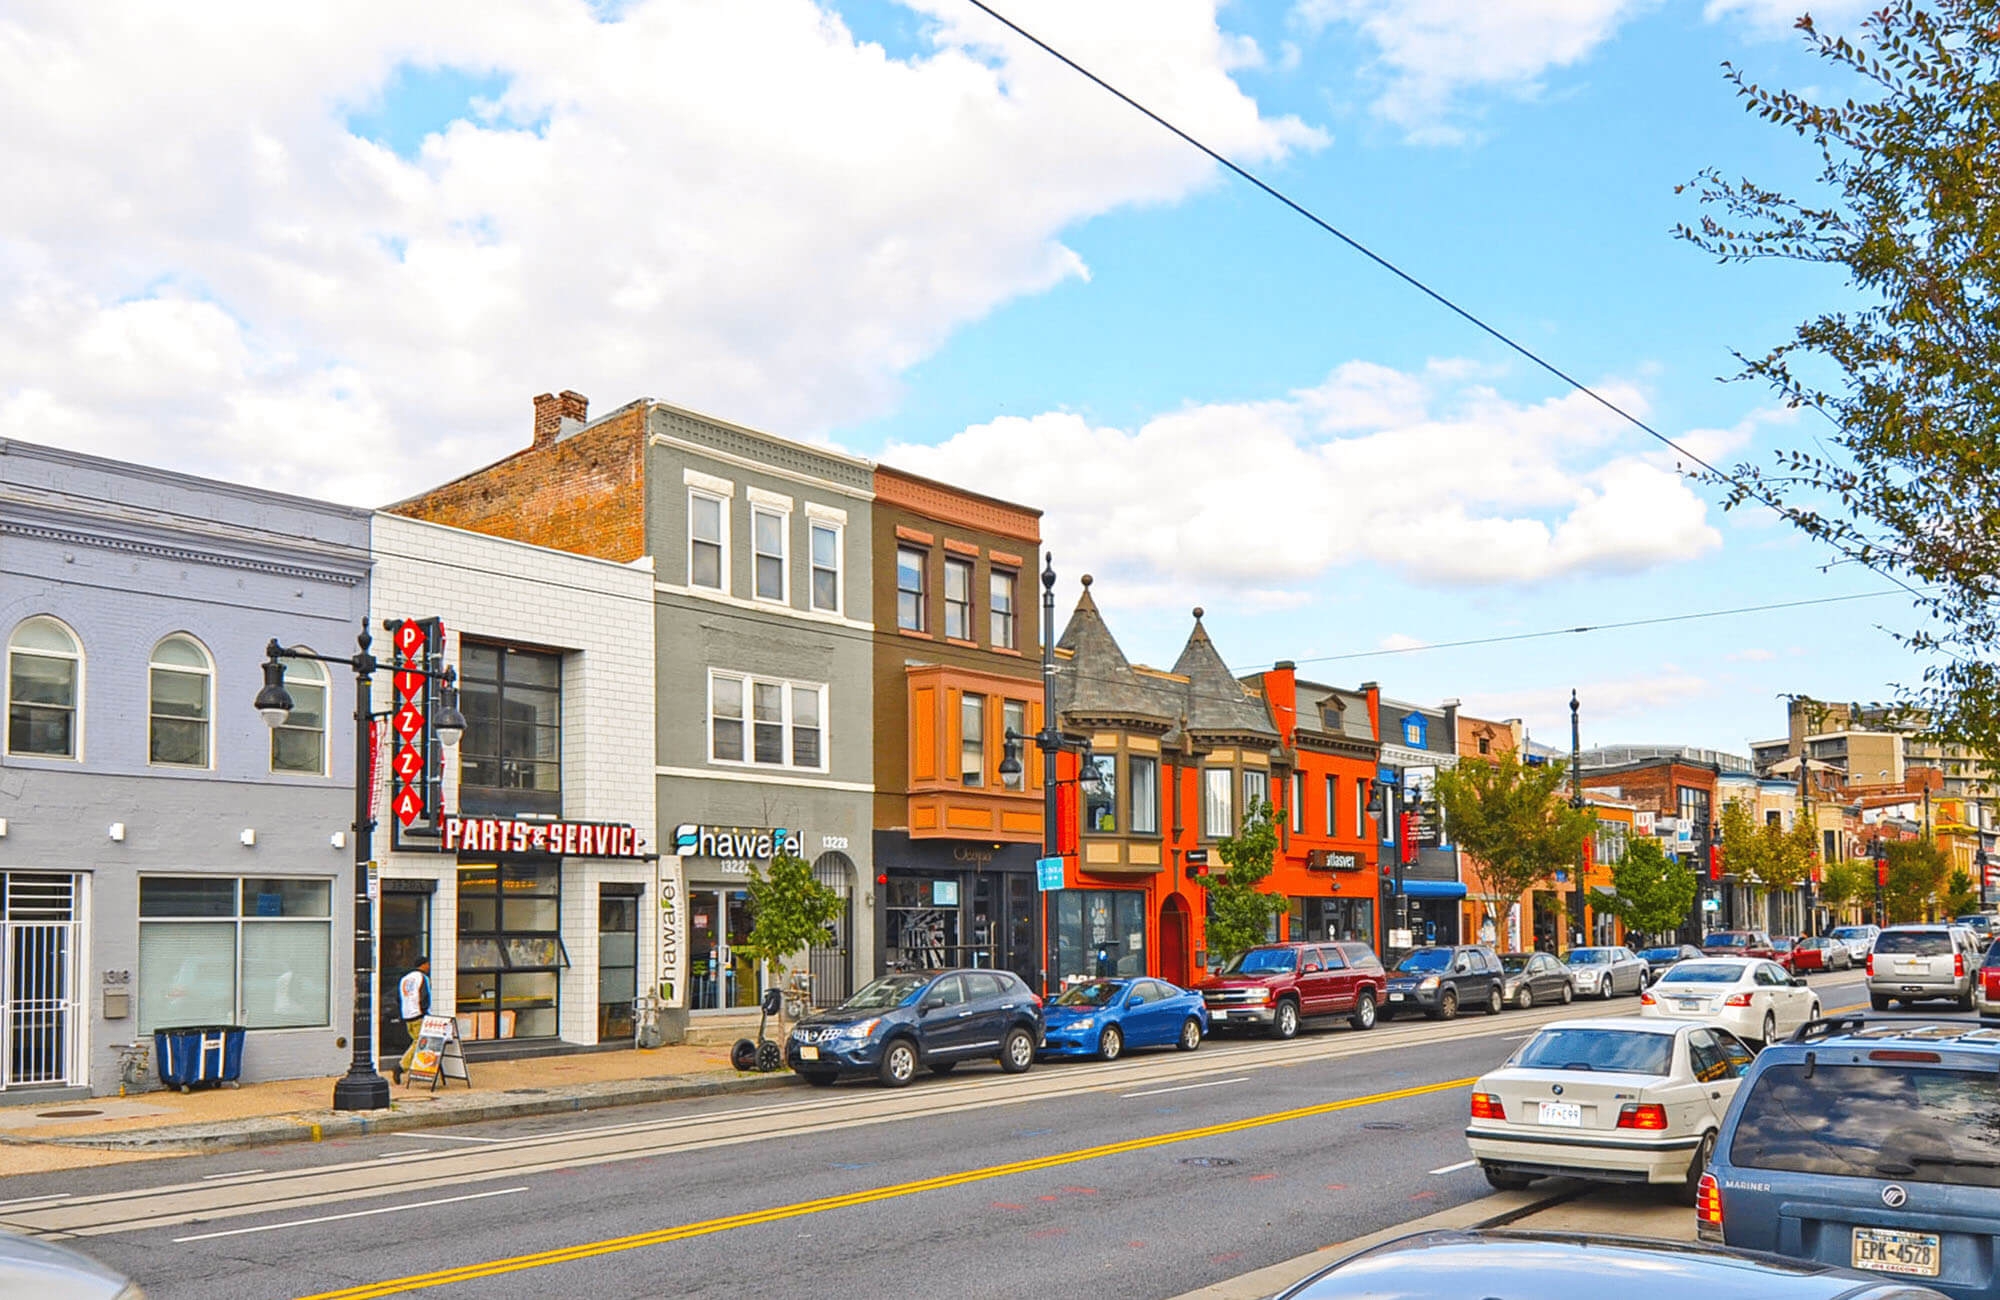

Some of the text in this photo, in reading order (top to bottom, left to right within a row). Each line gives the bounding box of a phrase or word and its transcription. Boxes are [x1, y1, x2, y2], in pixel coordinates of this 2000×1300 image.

[399, 627, 416, 814] PIZZA
[445, 817, 646, 856] PARTS & SERVICE
[1725, 1180, 1771, 1193] MARINER
